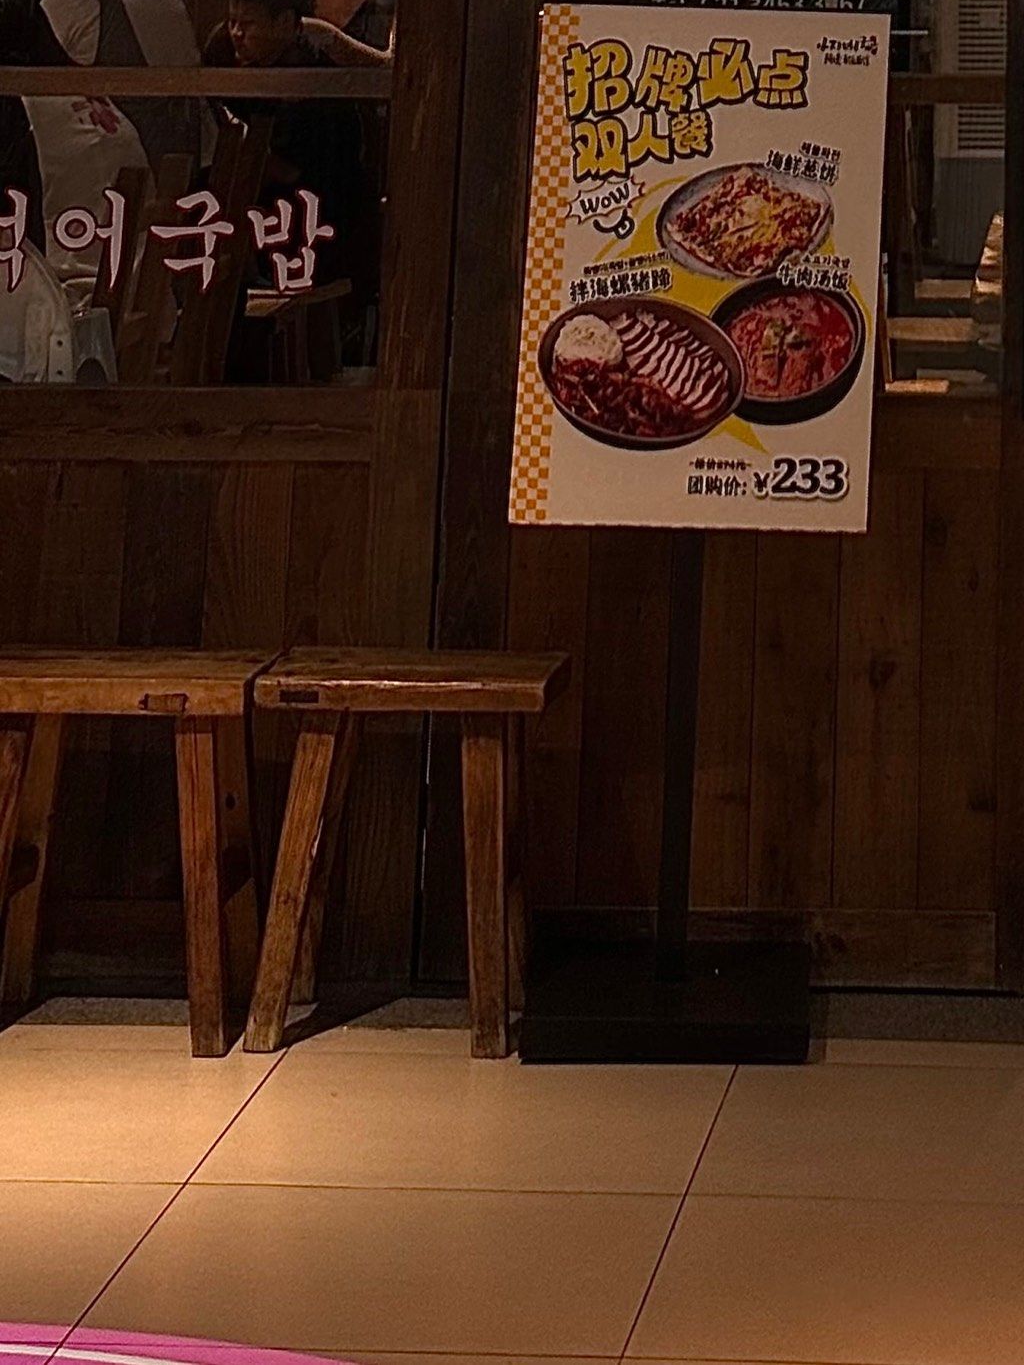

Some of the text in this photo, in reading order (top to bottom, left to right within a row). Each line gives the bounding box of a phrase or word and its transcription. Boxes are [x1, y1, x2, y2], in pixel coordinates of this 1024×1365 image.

[563, 39, 810, 117] 招牌必点
[571, 109, 713, 182] 双人餐
[779, 263, 848, 291] 牛肉汤饭
[754, 457, 846, 497] ¥233
